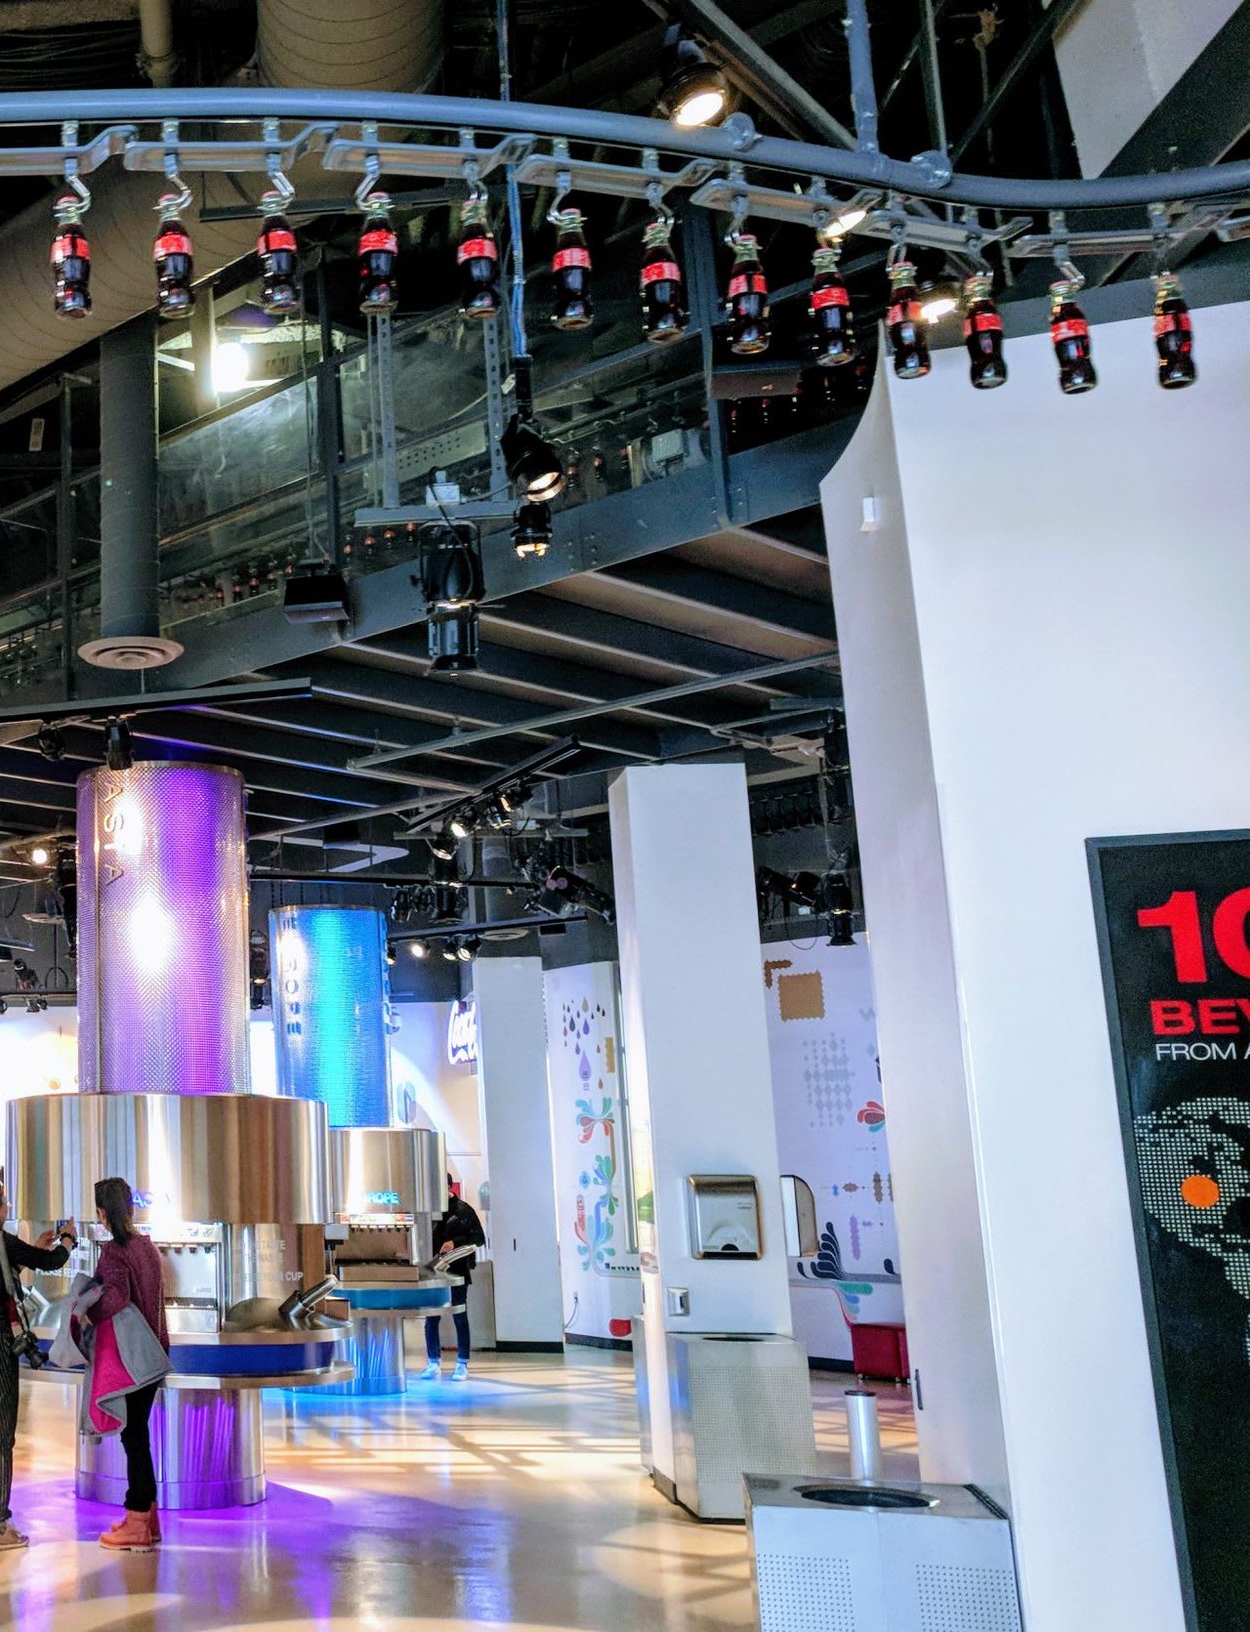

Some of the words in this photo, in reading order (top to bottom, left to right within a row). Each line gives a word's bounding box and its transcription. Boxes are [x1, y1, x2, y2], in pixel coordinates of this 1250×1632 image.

[104, 782, 124, 886] ASIA
[283, 917, 302, 1035] EOPE
[1155, 1042, 1237, 1061] FROM
[286, 1271, 304, 1282] CUP
